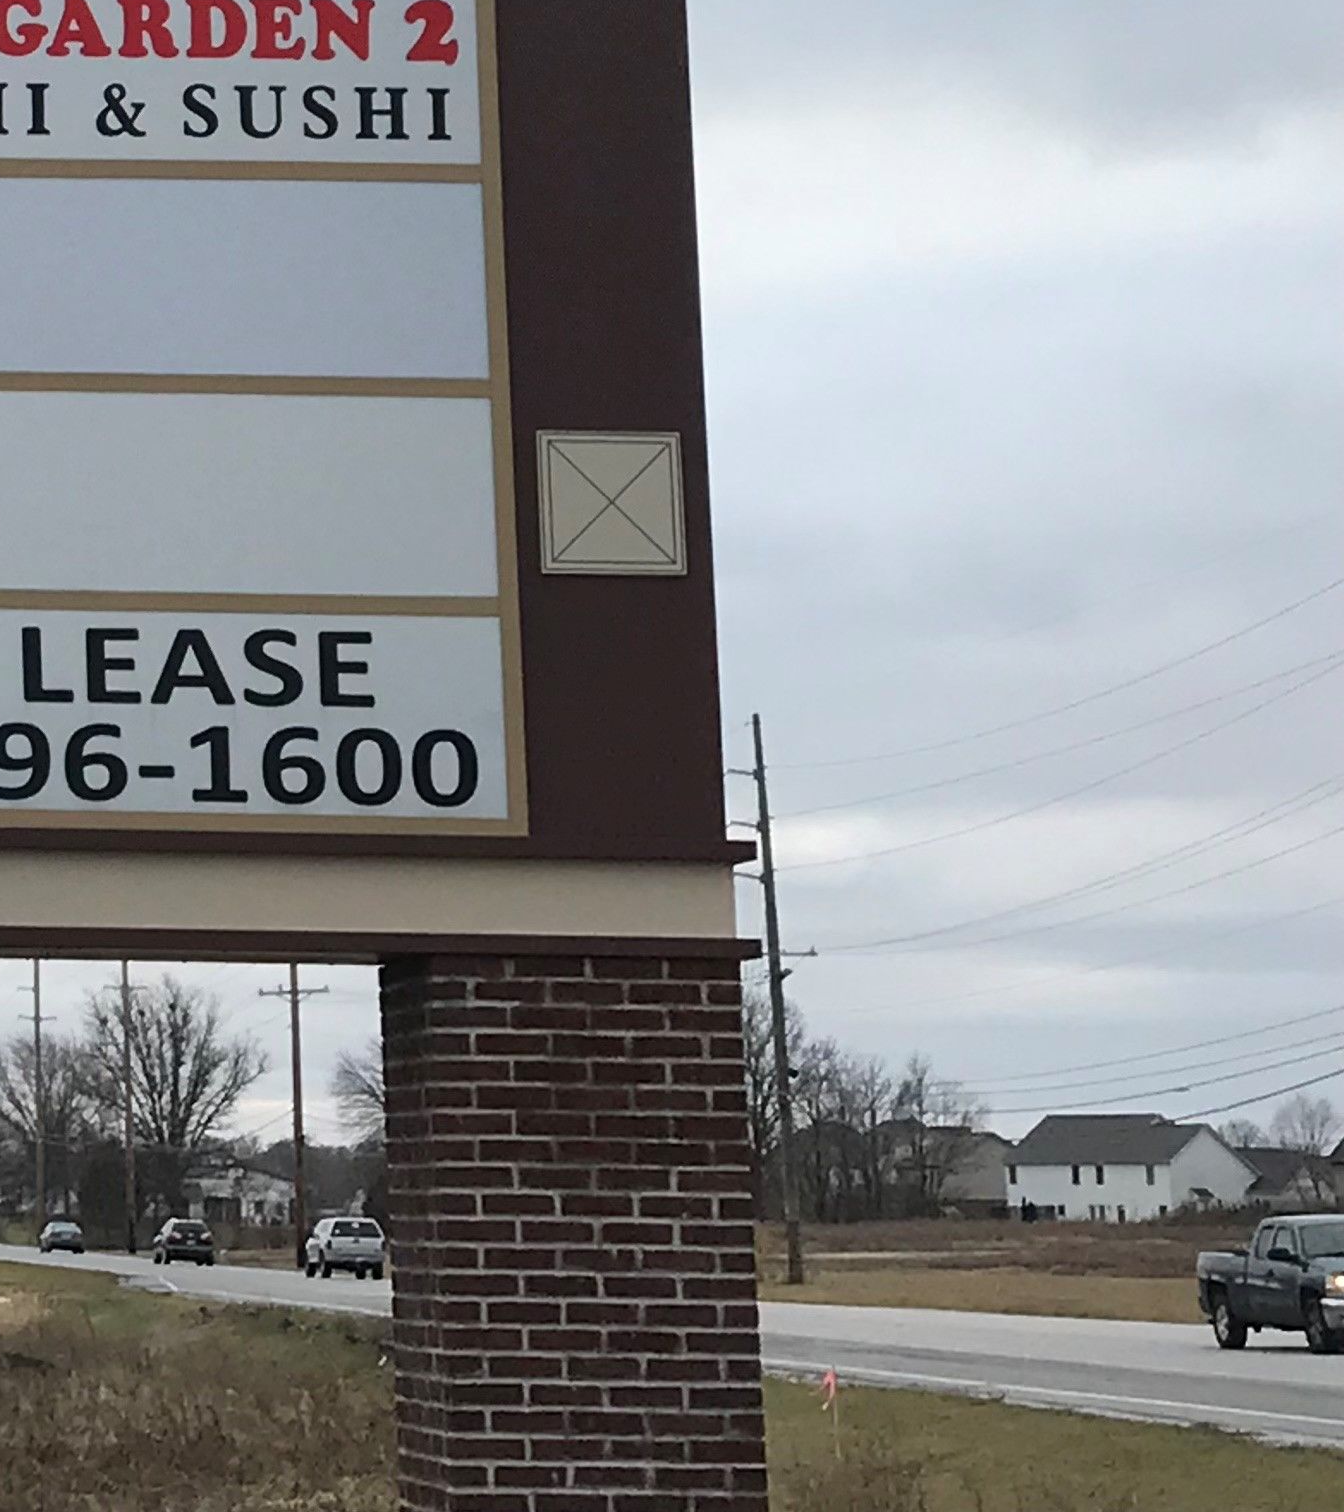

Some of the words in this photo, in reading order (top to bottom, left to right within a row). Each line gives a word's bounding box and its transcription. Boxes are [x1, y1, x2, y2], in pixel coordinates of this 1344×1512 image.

[404, 0, 458, 65] 2
[96, 83, 146, 137] &
[183, 84, 452, 140] SUSHI
[22, 627, 376, 708] LEASE
